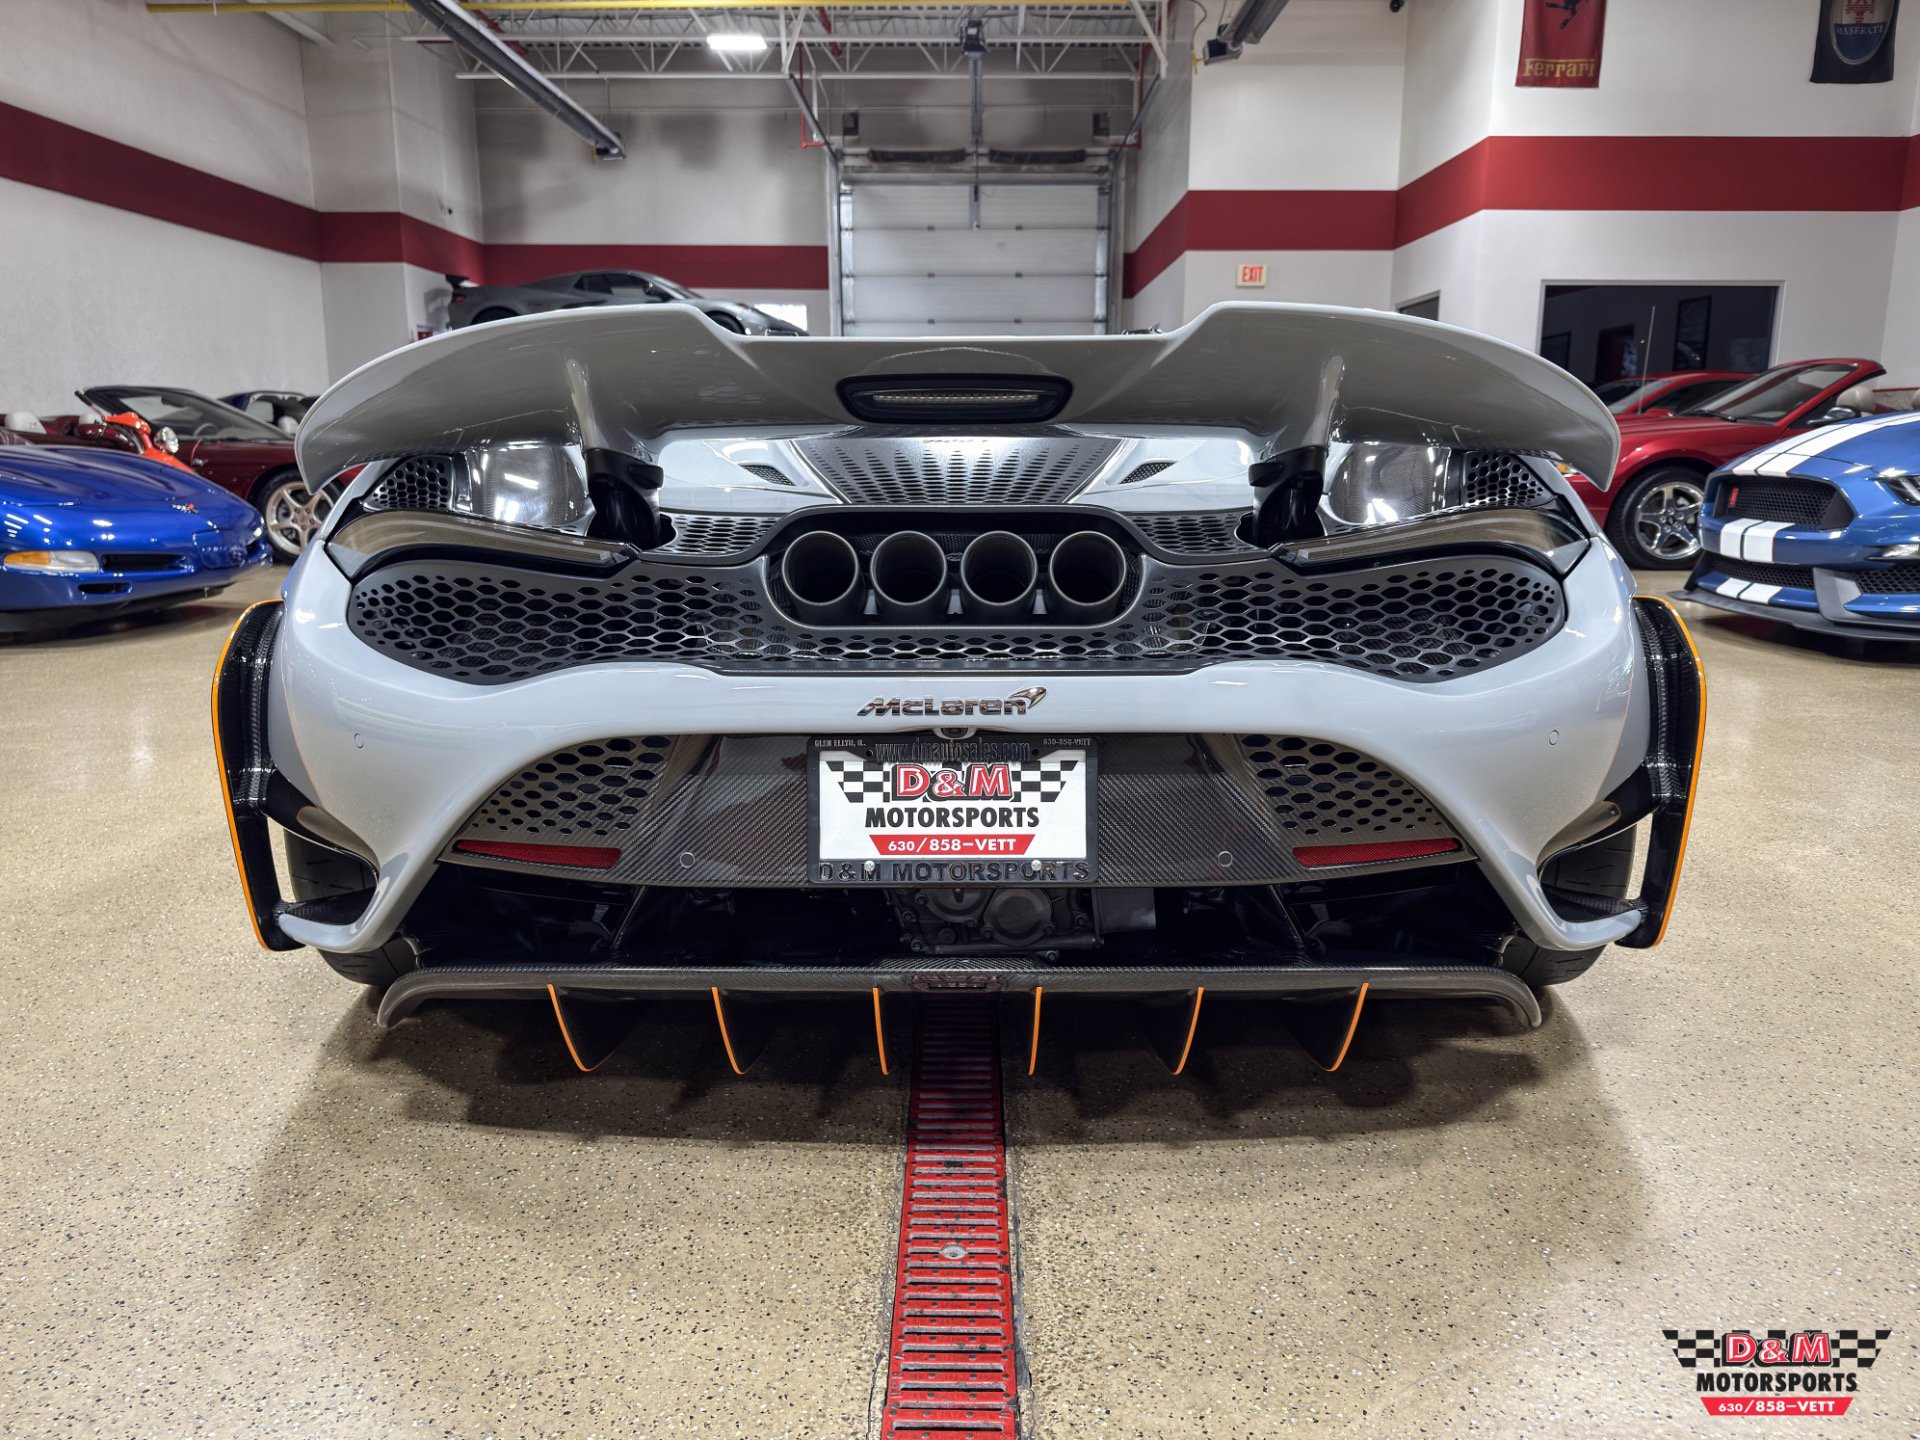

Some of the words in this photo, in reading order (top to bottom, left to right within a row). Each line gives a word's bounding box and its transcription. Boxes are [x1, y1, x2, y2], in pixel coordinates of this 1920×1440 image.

[1523, 57, 1595, 78] Ferrari
[1242, 265, 1263, 283] EXIT
[857, 696, 1028, 716] McLaren
[875, 737, 1031, 763] www.dmautosales.com
[893, 763, 1013, 800] D&M
[864, 807, 1040, 828] MOTORSPORTS
[888, 837, 1017, 853] 630/858-VETT
[892, 860, 1090, 882] MOTORSPORTS
